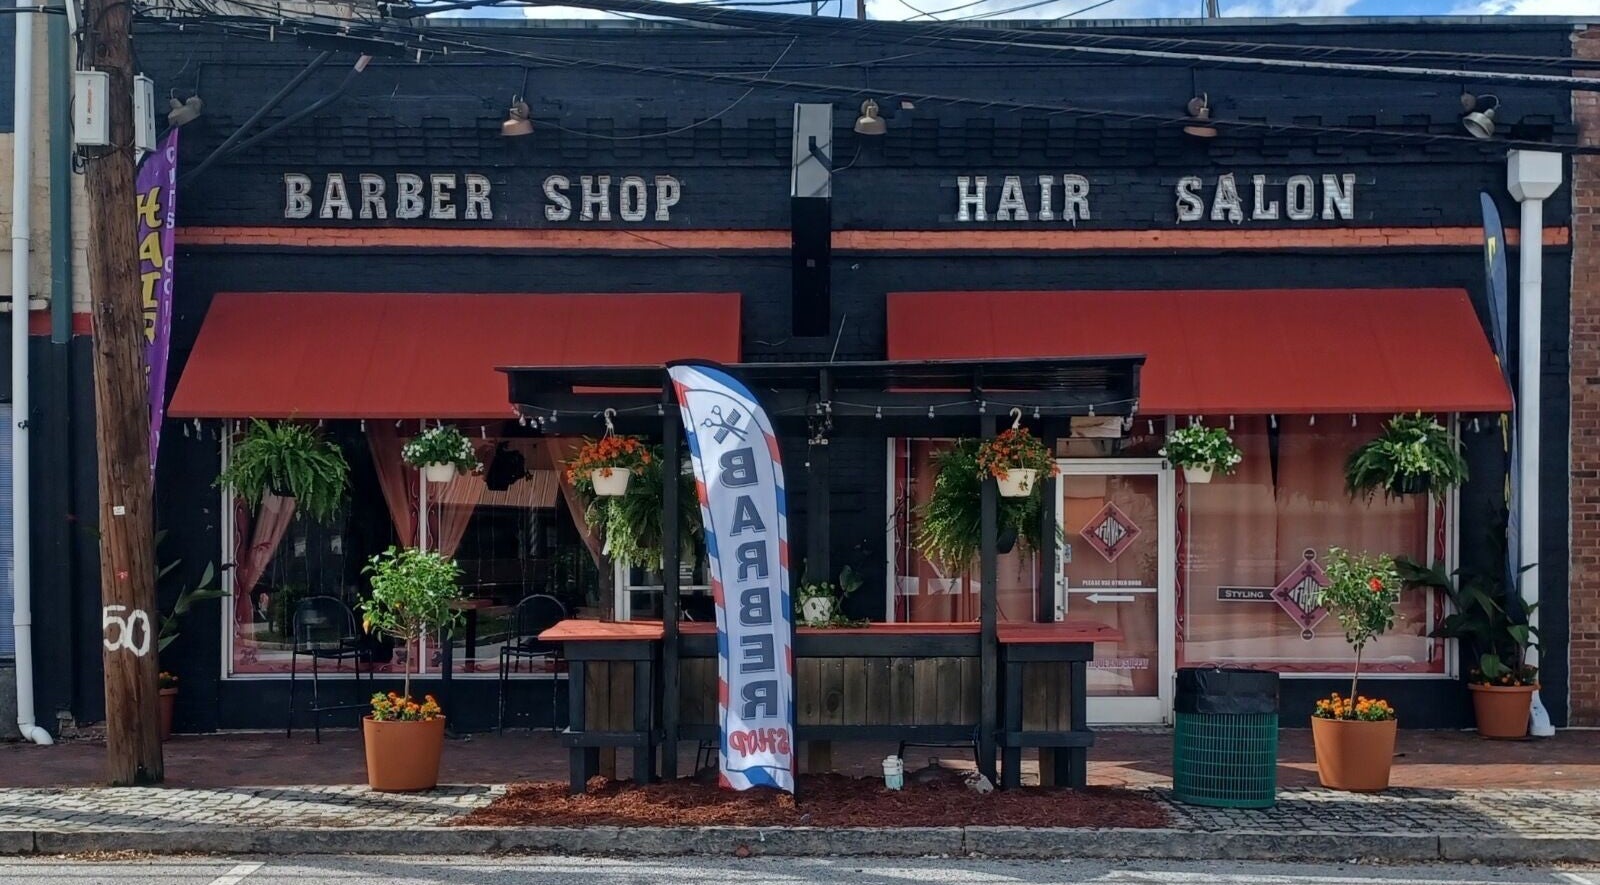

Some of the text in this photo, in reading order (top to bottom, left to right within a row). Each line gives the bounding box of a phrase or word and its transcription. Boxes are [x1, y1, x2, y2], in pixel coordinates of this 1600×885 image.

[284, 172, 681, 221] BARBER SHOP
[957, 172, 1356, 223] HAIR SALON
[136, 187, 163, 344] HAIR
[1225, 590, 1264, 599] STYLING
[103, 605, 150, 657] 50
